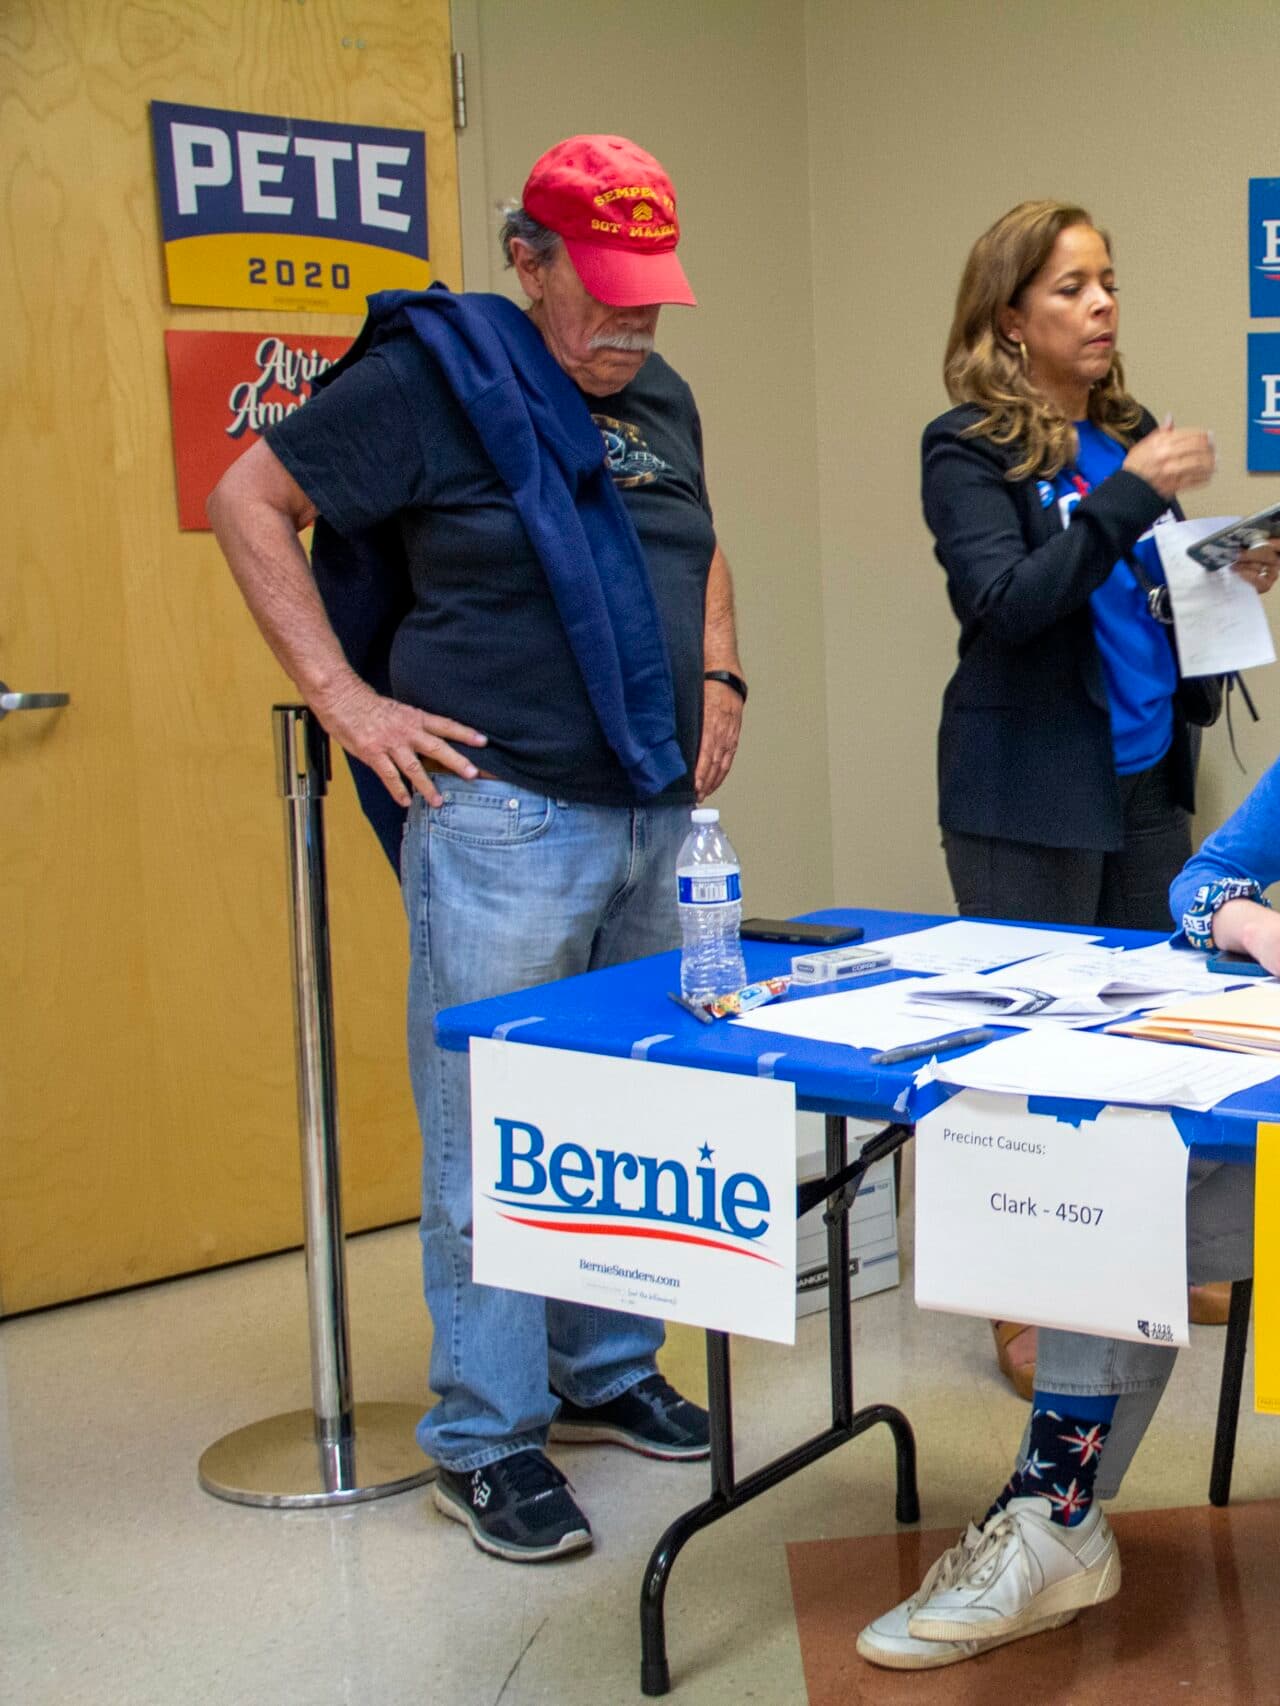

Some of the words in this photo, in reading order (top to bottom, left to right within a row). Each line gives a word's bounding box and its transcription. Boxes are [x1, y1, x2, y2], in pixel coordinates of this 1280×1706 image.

[169, 121, 412, 233] PETE
[248, 257, 351, 290] 2020
[255, 336, 341, 391] Afric
[943, 1127, 994, 1149] Precinct
[493, 1116, 771, 1240] Bernie
[989, 1191, 1038, 1217] Clark
[1054, 1202, 1104, 1227] 4507
[578, 1258, 681, 1289] BernieSanders.com
